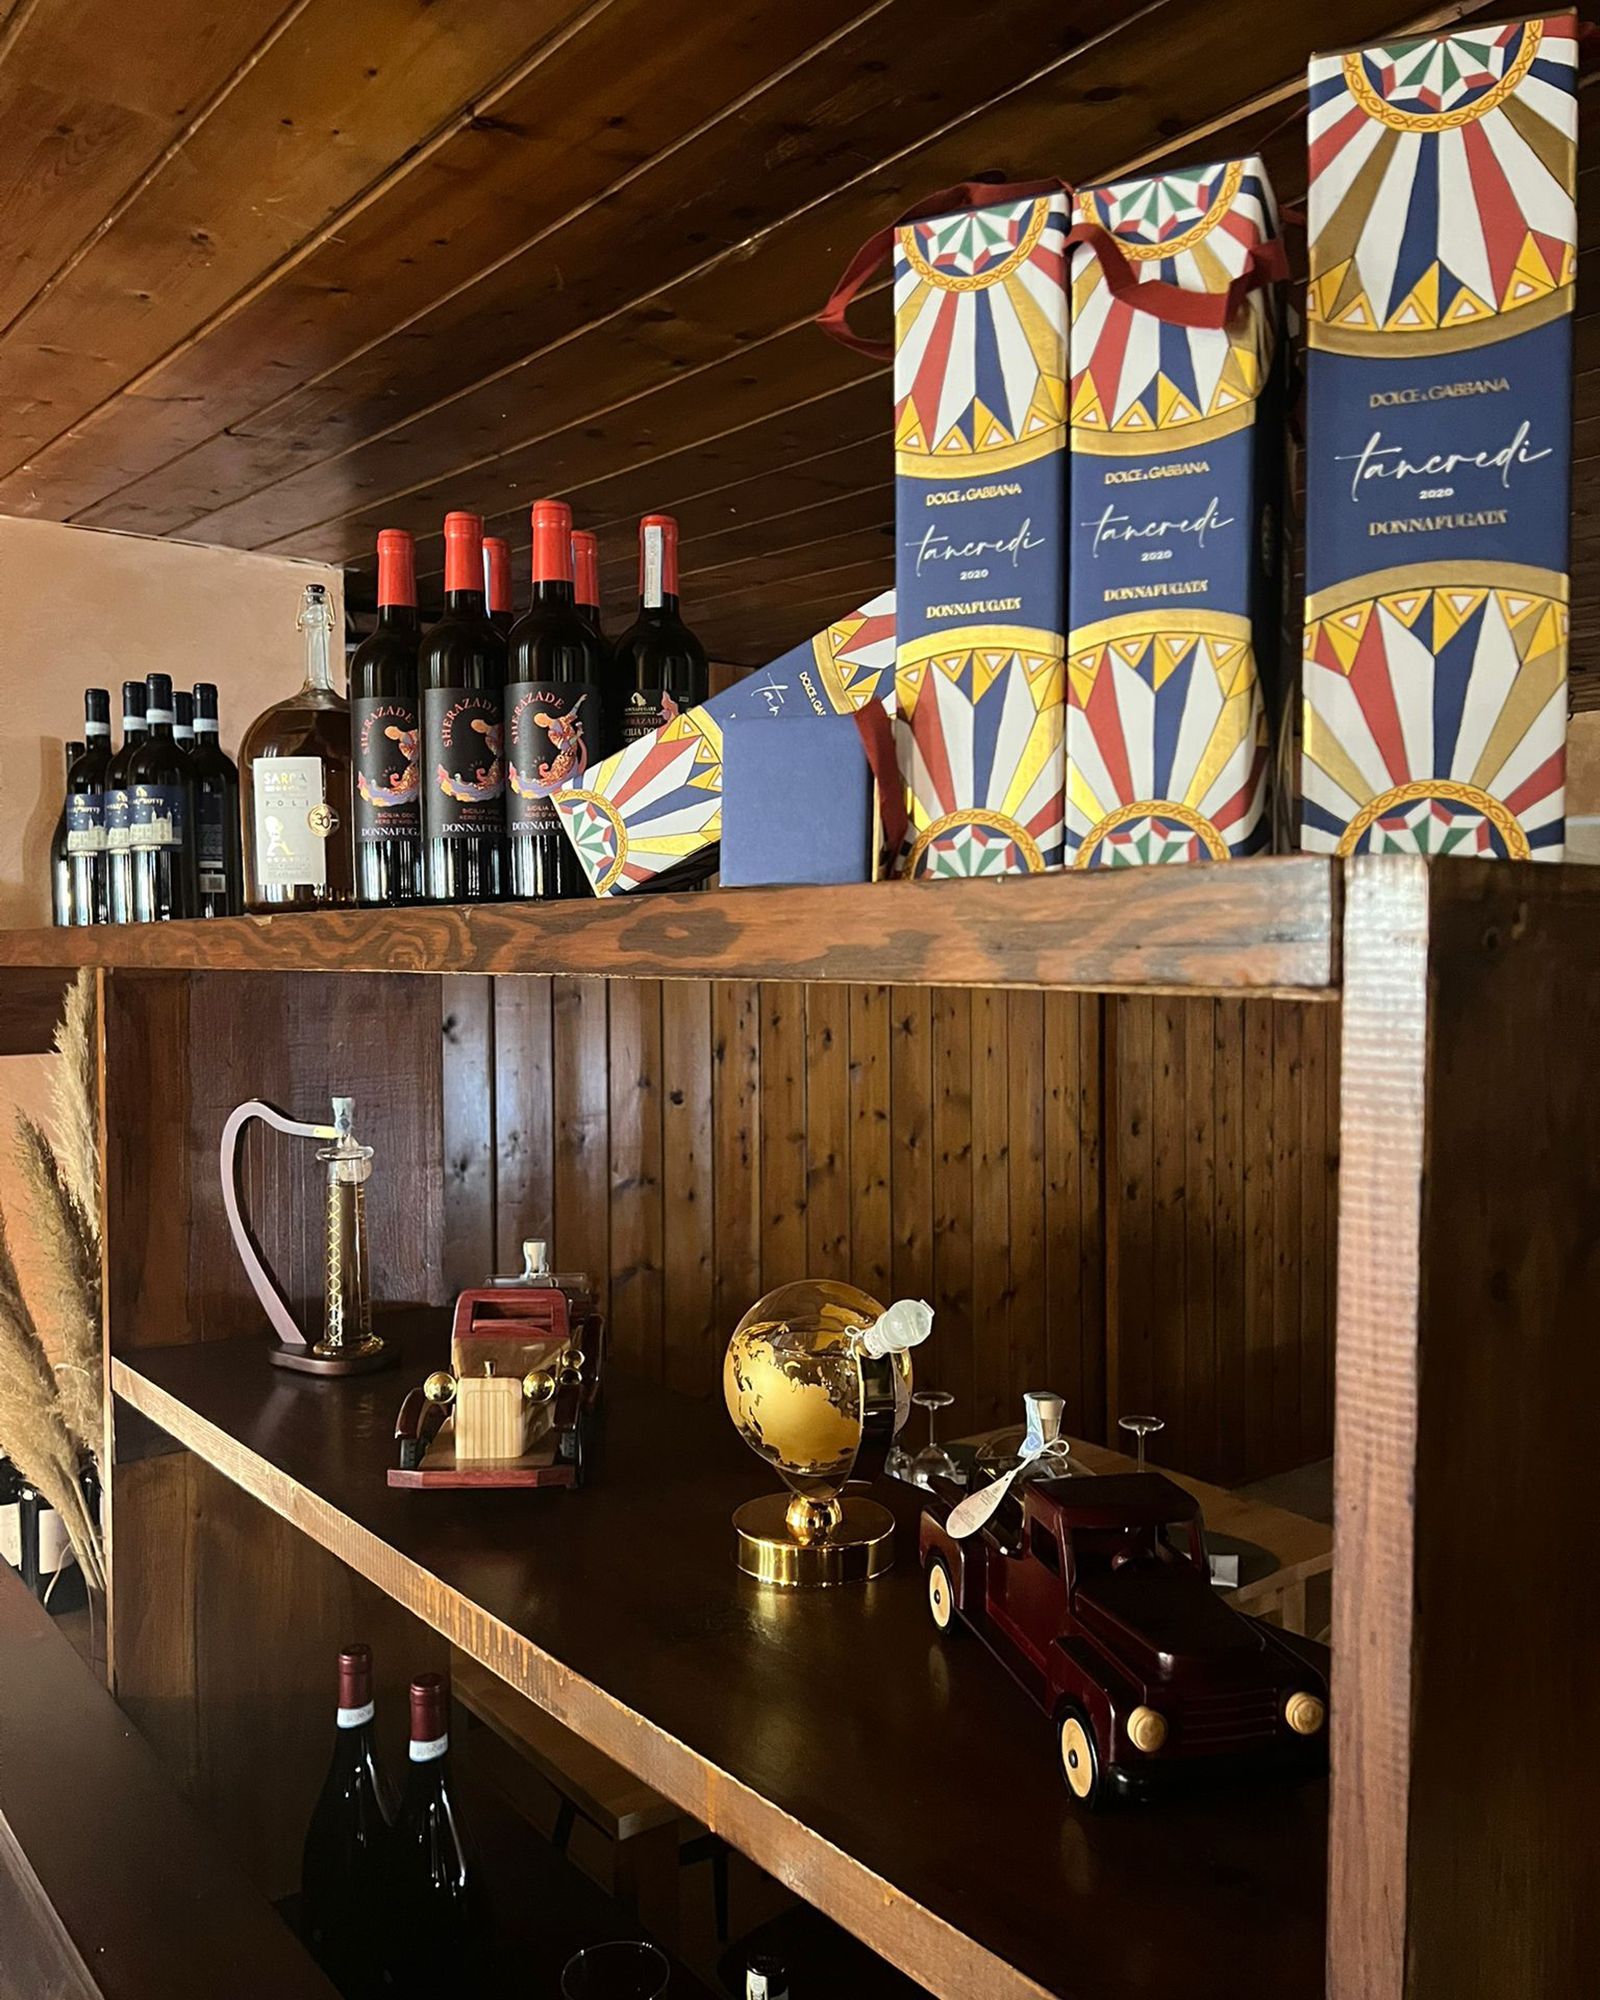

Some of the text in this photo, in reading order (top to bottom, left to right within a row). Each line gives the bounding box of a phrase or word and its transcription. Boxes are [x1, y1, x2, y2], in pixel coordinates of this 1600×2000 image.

[1333, 420, 1553, 503] tancredi
[1418, 487, 1455, 500] 2020
[1080, 496, 1235, 560] tancredi
[1368, 508, 1509, 537] DONNAFUGATA
[904, 517, 1046, 578] tancredi
[1140, 549, 1173, 563] 2020
[959, 568, 990, 581] 2020
[1103, 579, 1210, 603] DONNAFUGATA
[925, 596, 1023, 620] DONNAFUGATA
[360, 704, 416, 756] SHERAZADE
[511, 690, 565, 745] SHERAZADE
[361, 825, 420, 837] DONNAFUG
